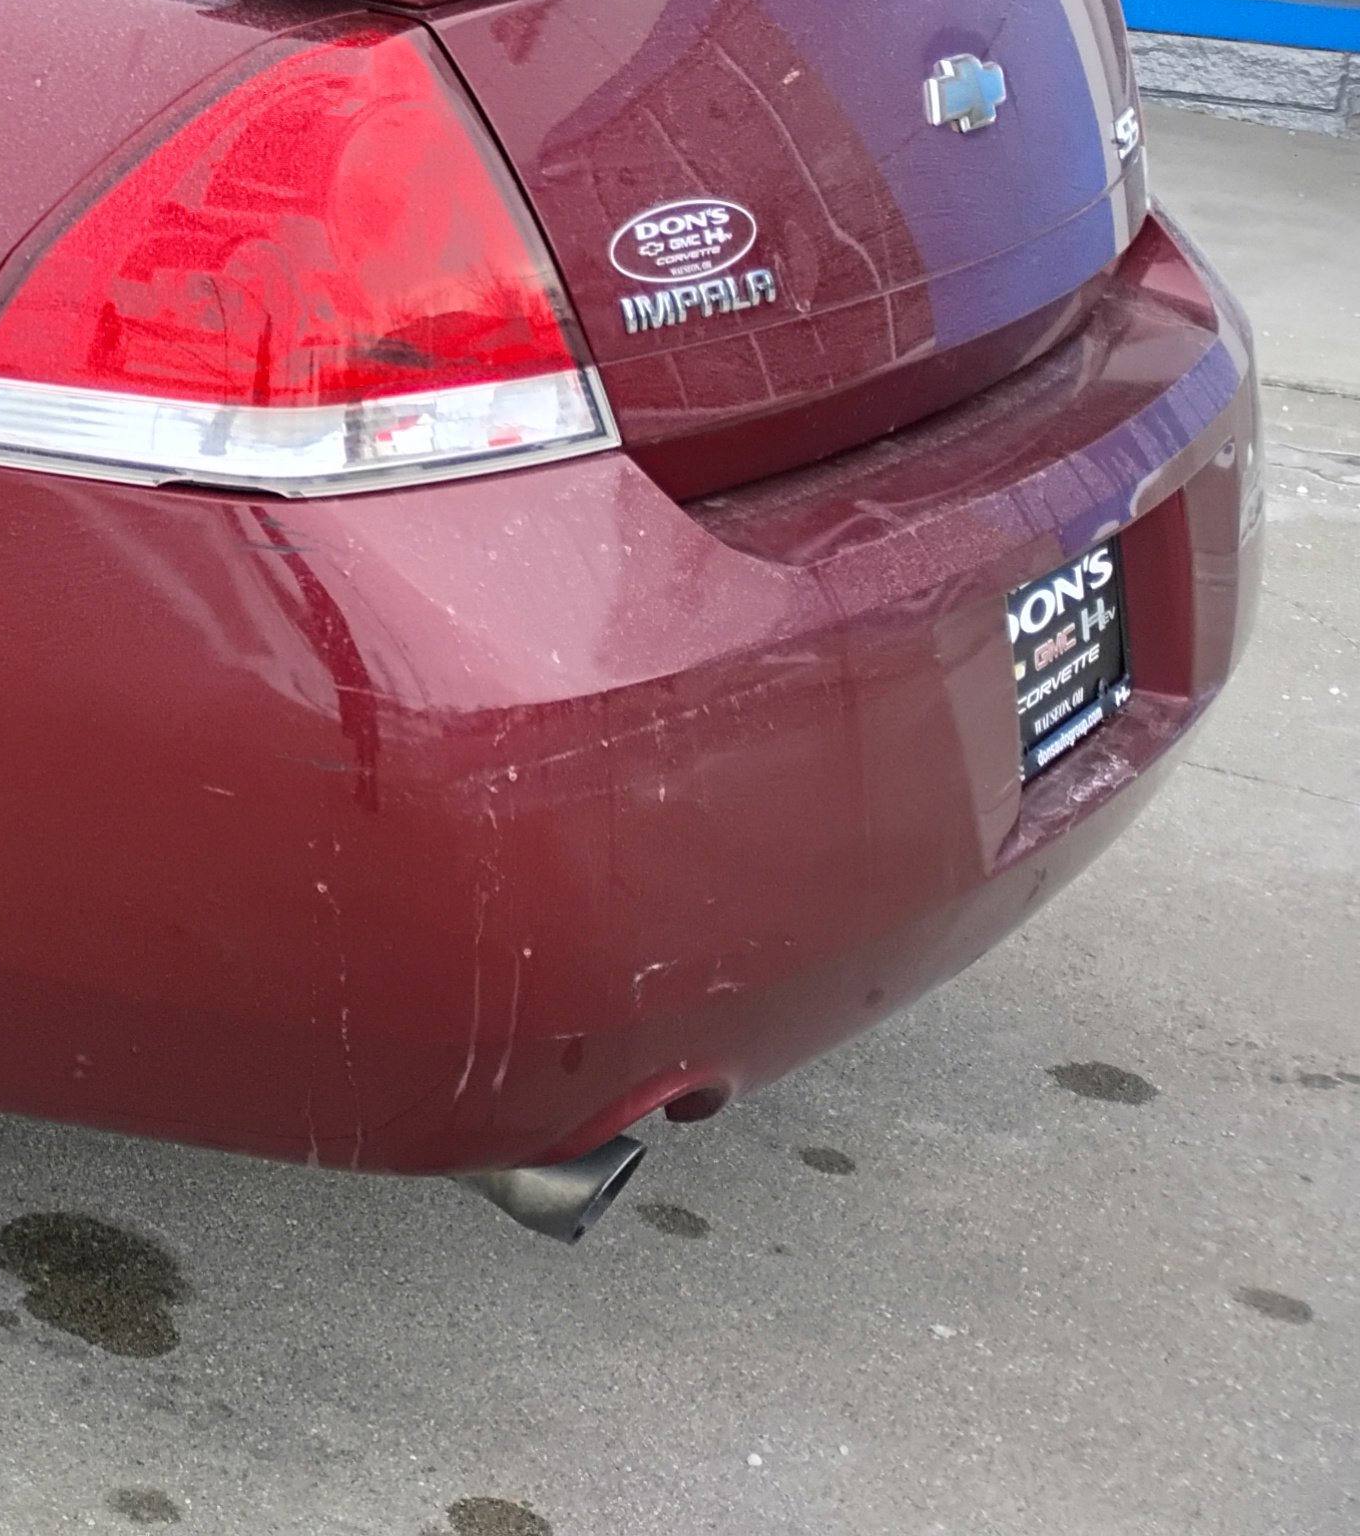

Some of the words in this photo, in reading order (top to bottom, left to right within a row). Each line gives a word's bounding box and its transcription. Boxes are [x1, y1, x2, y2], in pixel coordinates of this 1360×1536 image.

[634, 208, 730, 240] DON'S
[655, 246, 721, 267] CORVETTE
[669, 234, 701, 250] GMC
[620, 269, 777, 334] IMPALA
[1034, 622, 1077, 672] GMC
